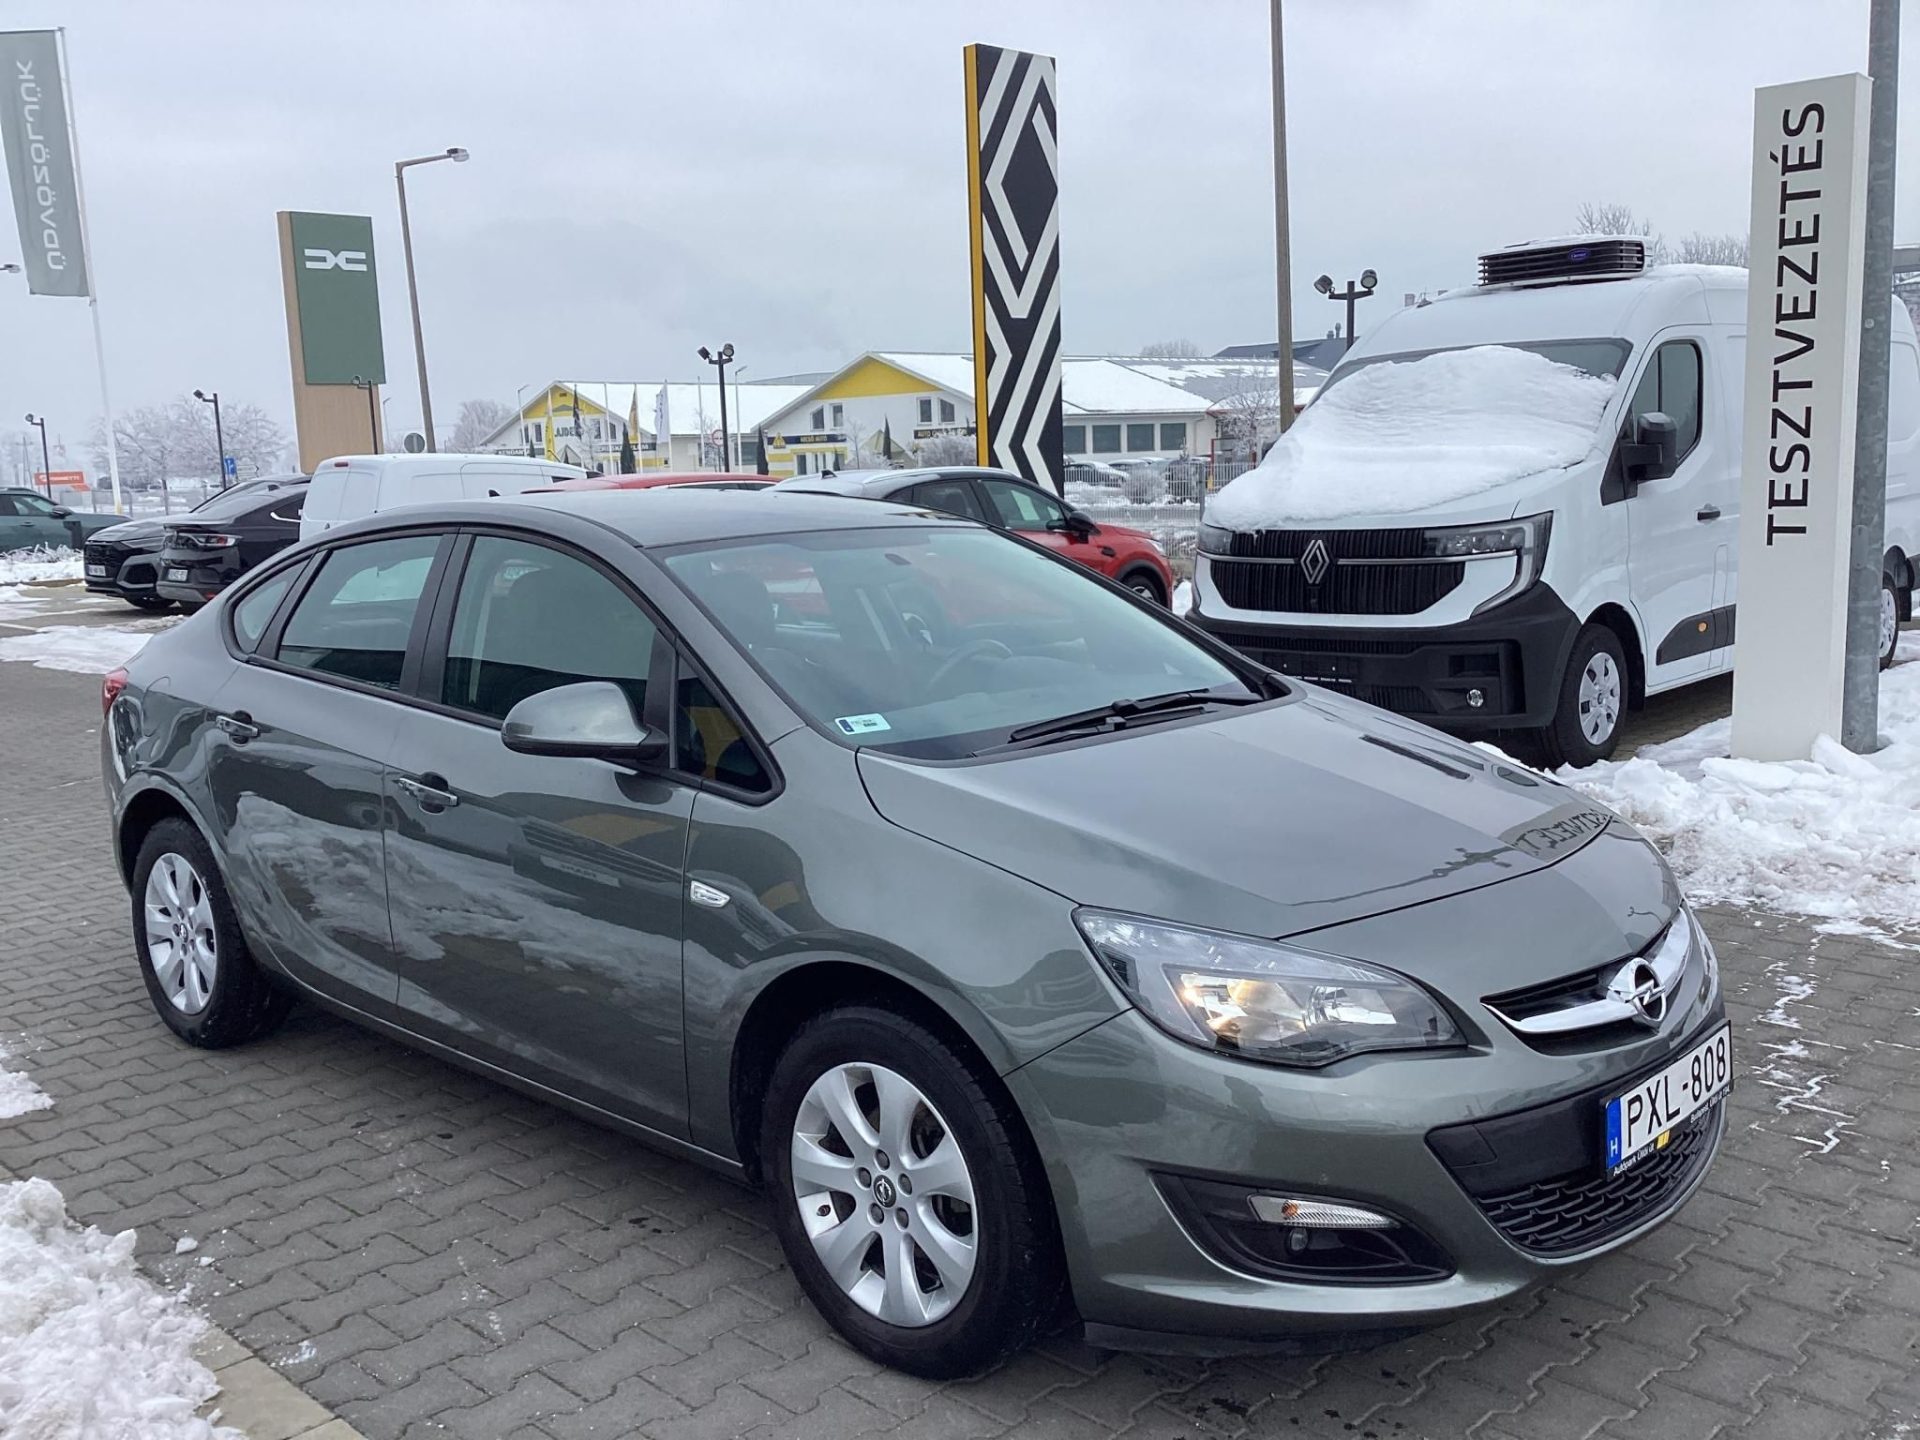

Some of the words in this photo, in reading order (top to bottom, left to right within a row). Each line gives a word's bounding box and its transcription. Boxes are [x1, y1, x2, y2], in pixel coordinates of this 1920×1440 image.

[1766, 102, 1825, 546] TESZTVEZETÉS
[1611, 1137, 1618, 1158] H
[1627, 1036, 1726, 1148] PXL-808
